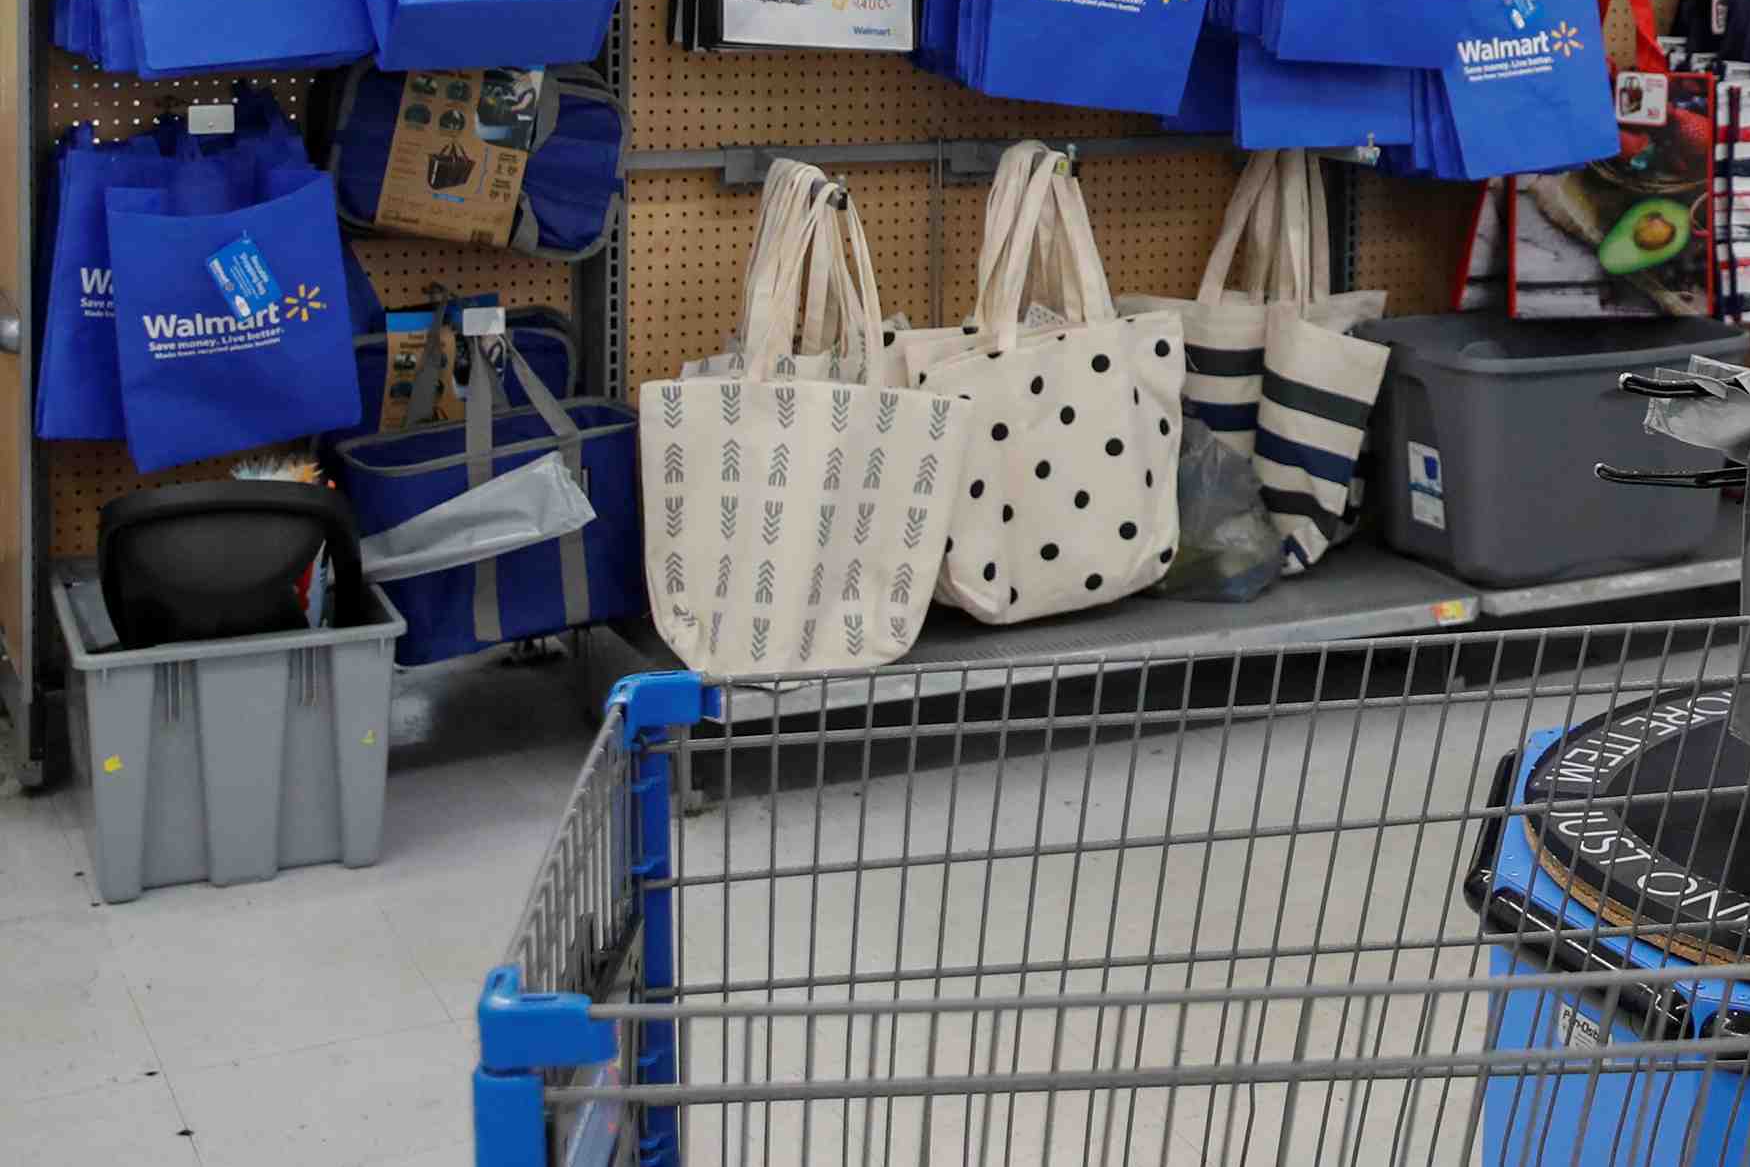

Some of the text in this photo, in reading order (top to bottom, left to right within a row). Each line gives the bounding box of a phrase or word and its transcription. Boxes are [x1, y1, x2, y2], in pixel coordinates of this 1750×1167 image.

[853, 26, 891, 35] Walmart
[1457, 30, 1550, 64] Walmart
[80, 297, 105, 309] Save
[143, 301, 281, 339] Walmart
[148, 327, 285, 353] Save money. Live better.
[1620, 691, 1733, 736] ORE
[1550, 811, 1660, 865] JUST
